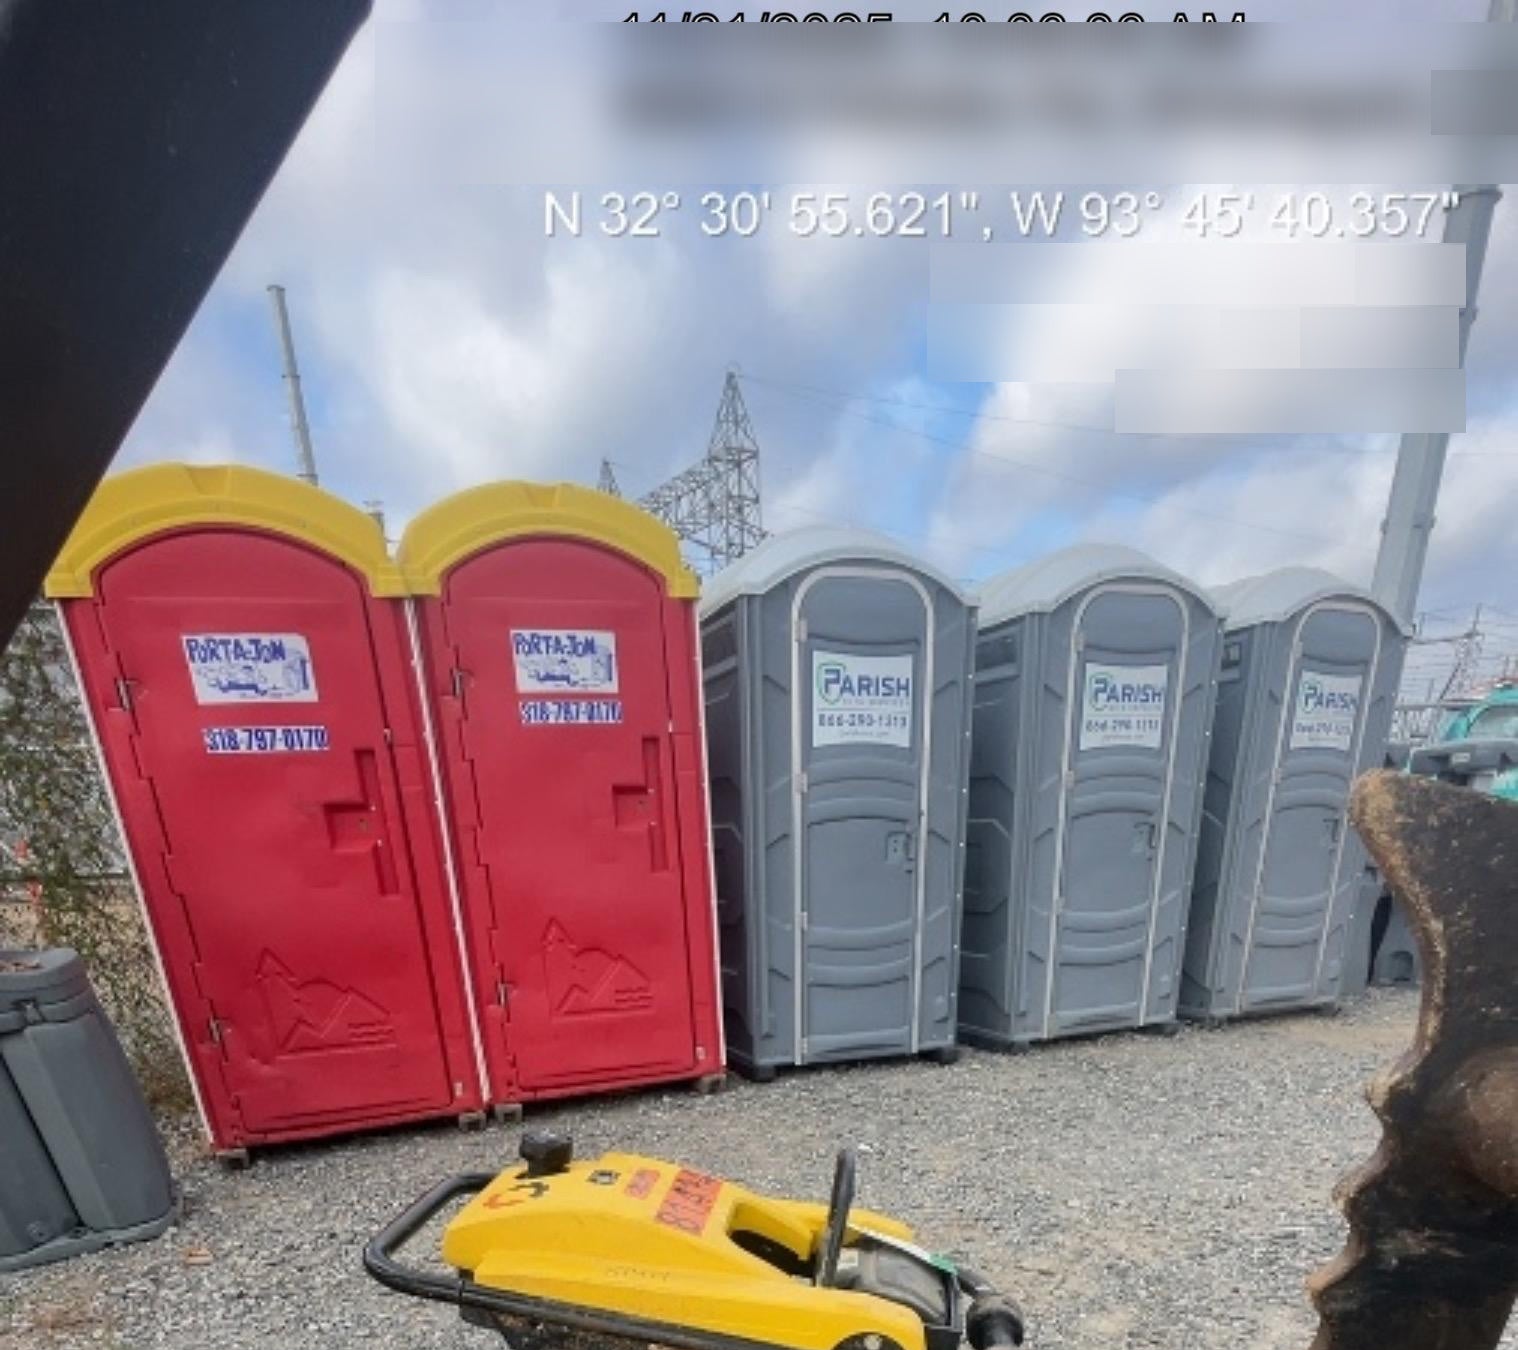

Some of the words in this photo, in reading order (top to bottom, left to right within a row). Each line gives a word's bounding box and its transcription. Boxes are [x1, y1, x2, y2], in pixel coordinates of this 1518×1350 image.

[823, 667, 911, 697] PARISH
[1093, 677, 1163, 703] PARISH
[206, 727, 328, 752] 318-797-0170
